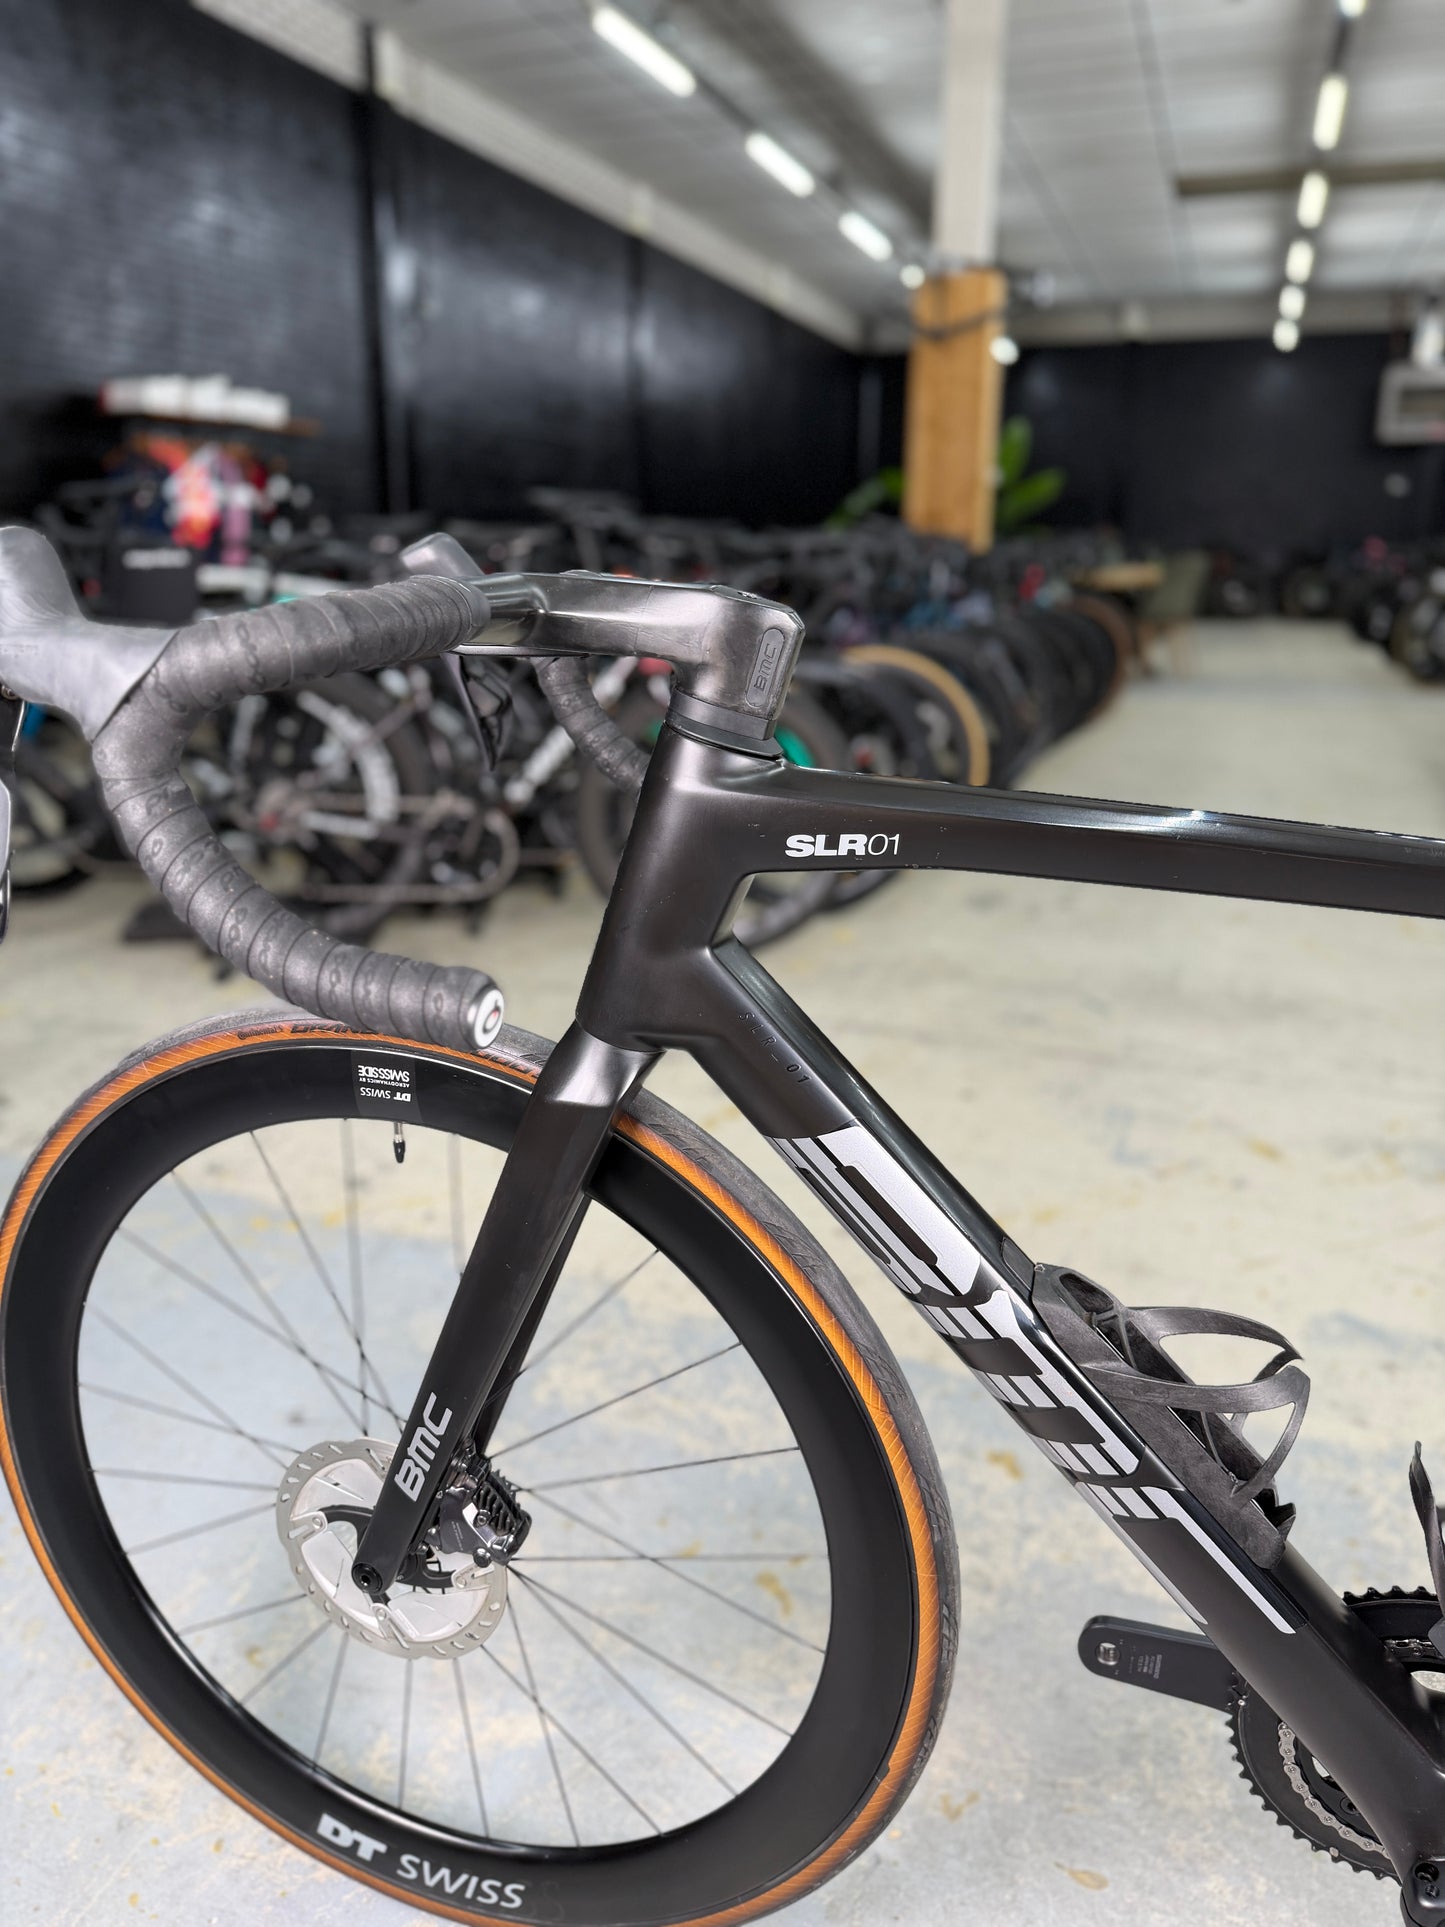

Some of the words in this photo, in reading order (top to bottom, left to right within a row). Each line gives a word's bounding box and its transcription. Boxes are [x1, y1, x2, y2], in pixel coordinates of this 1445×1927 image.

[754, 643, 777, 692] BMC
[784, 833, 900, 857] SLR01
[360, 1087, 391, 1099] SWISS
[393, 1092, 411, 1102] DT
[394, 1391, 453, 1502] BMC
[317, 1813, 388, 1862] DT
[397, 1854, 526, 1909] SWISS
